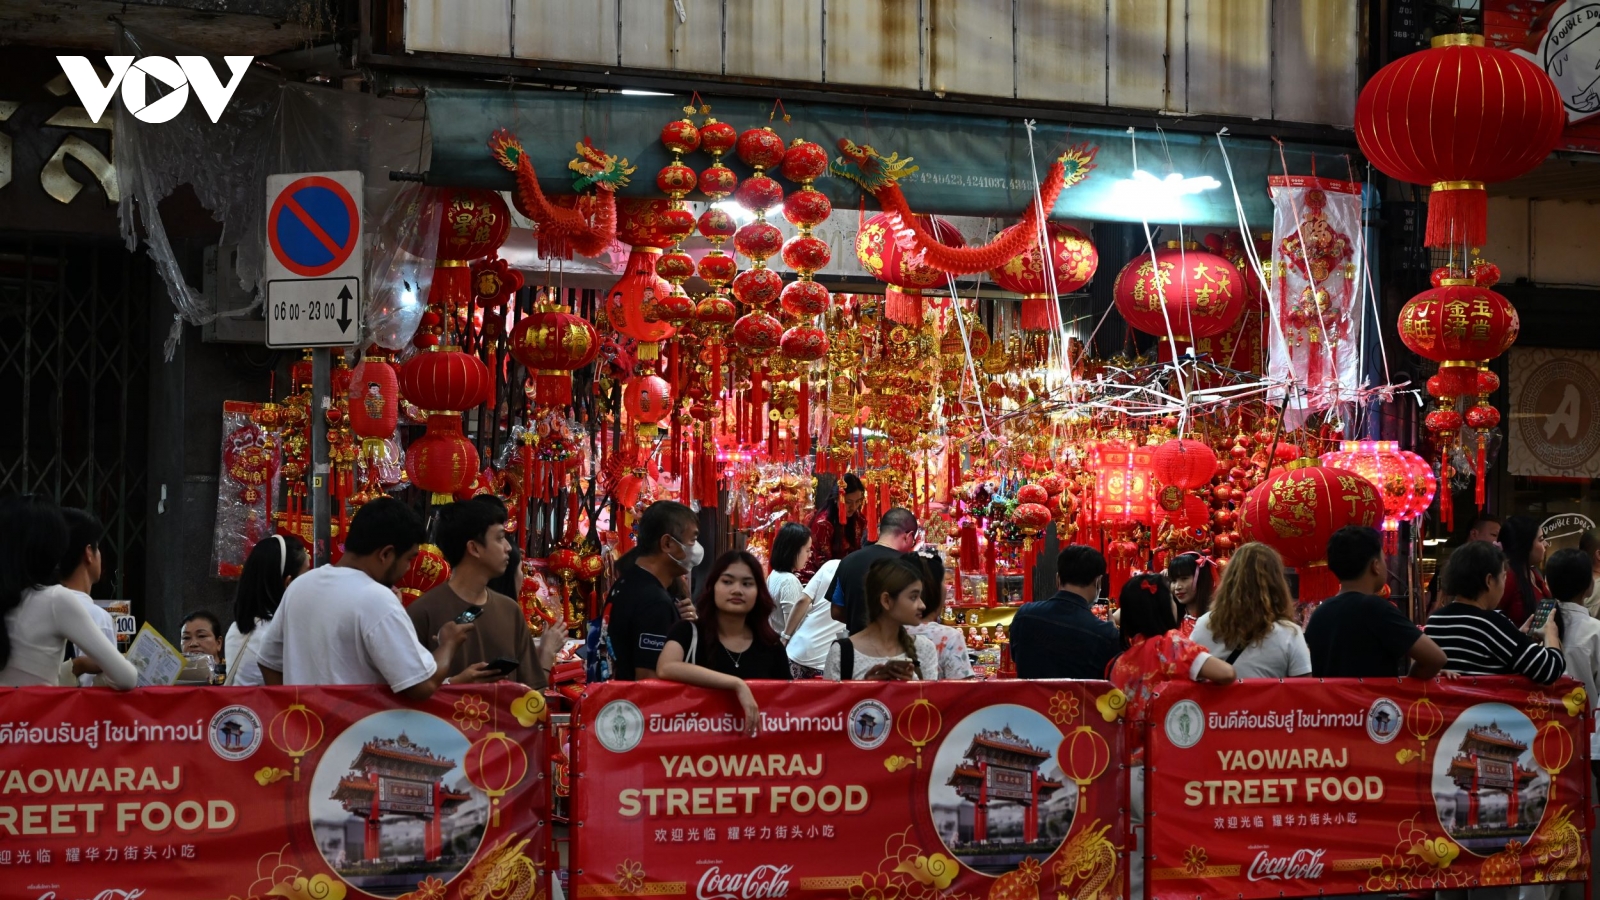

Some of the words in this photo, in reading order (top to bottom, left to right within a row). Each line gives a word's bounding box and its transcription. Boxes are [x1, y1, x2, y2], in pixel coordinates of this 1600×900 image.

[1551, 14, 1583, 46] DOUBLE
[1585, 9, 1600, 20] DO
[274, 301, 287, 321] 06
[289, 303, 300, 320] 00
[308, 301, 321, 320] 23
[324, 302, 336, 319] 00
[1542, 518, 1570, 535] DOUBLE
[116, 617, 134, 633] 100
[103, 718, 204, 742] ไชน่าทาวน์
[760, 711, 843, 732] ไชน่าทาวน์
[1208, 709, 1294, 734] ยินดีต้อนรับสู่
[1297, 708, 1365, 728] ไชน่าทาวน์
[660, 753, 823, 777] YAOWARAJ
[1217, 748, 1348, 771] YAOWARAJ
[618, 786, 760, 816] STREET
[770, 784, 869, 813] FOOD
[1184, 777, 1298, 807] STREET
[1305, 775, 1384, 802] FOOD
[117, 800, 236, 833] FOOD
[1213, 815, 1264, 830] 欢迎光临
[1272, 812, 1358, 828] 耀华力街头小吃
[654, 827, 716, 842] 欢迎光临
[727, 824, 835, 840] 耀华力街头小吃
[65, 844, 196, 863] 耀华力街头小吃
[1247, 848, 1327, 882] Coca-Cola
[696, 864, 794, 900] Coca-Cola
